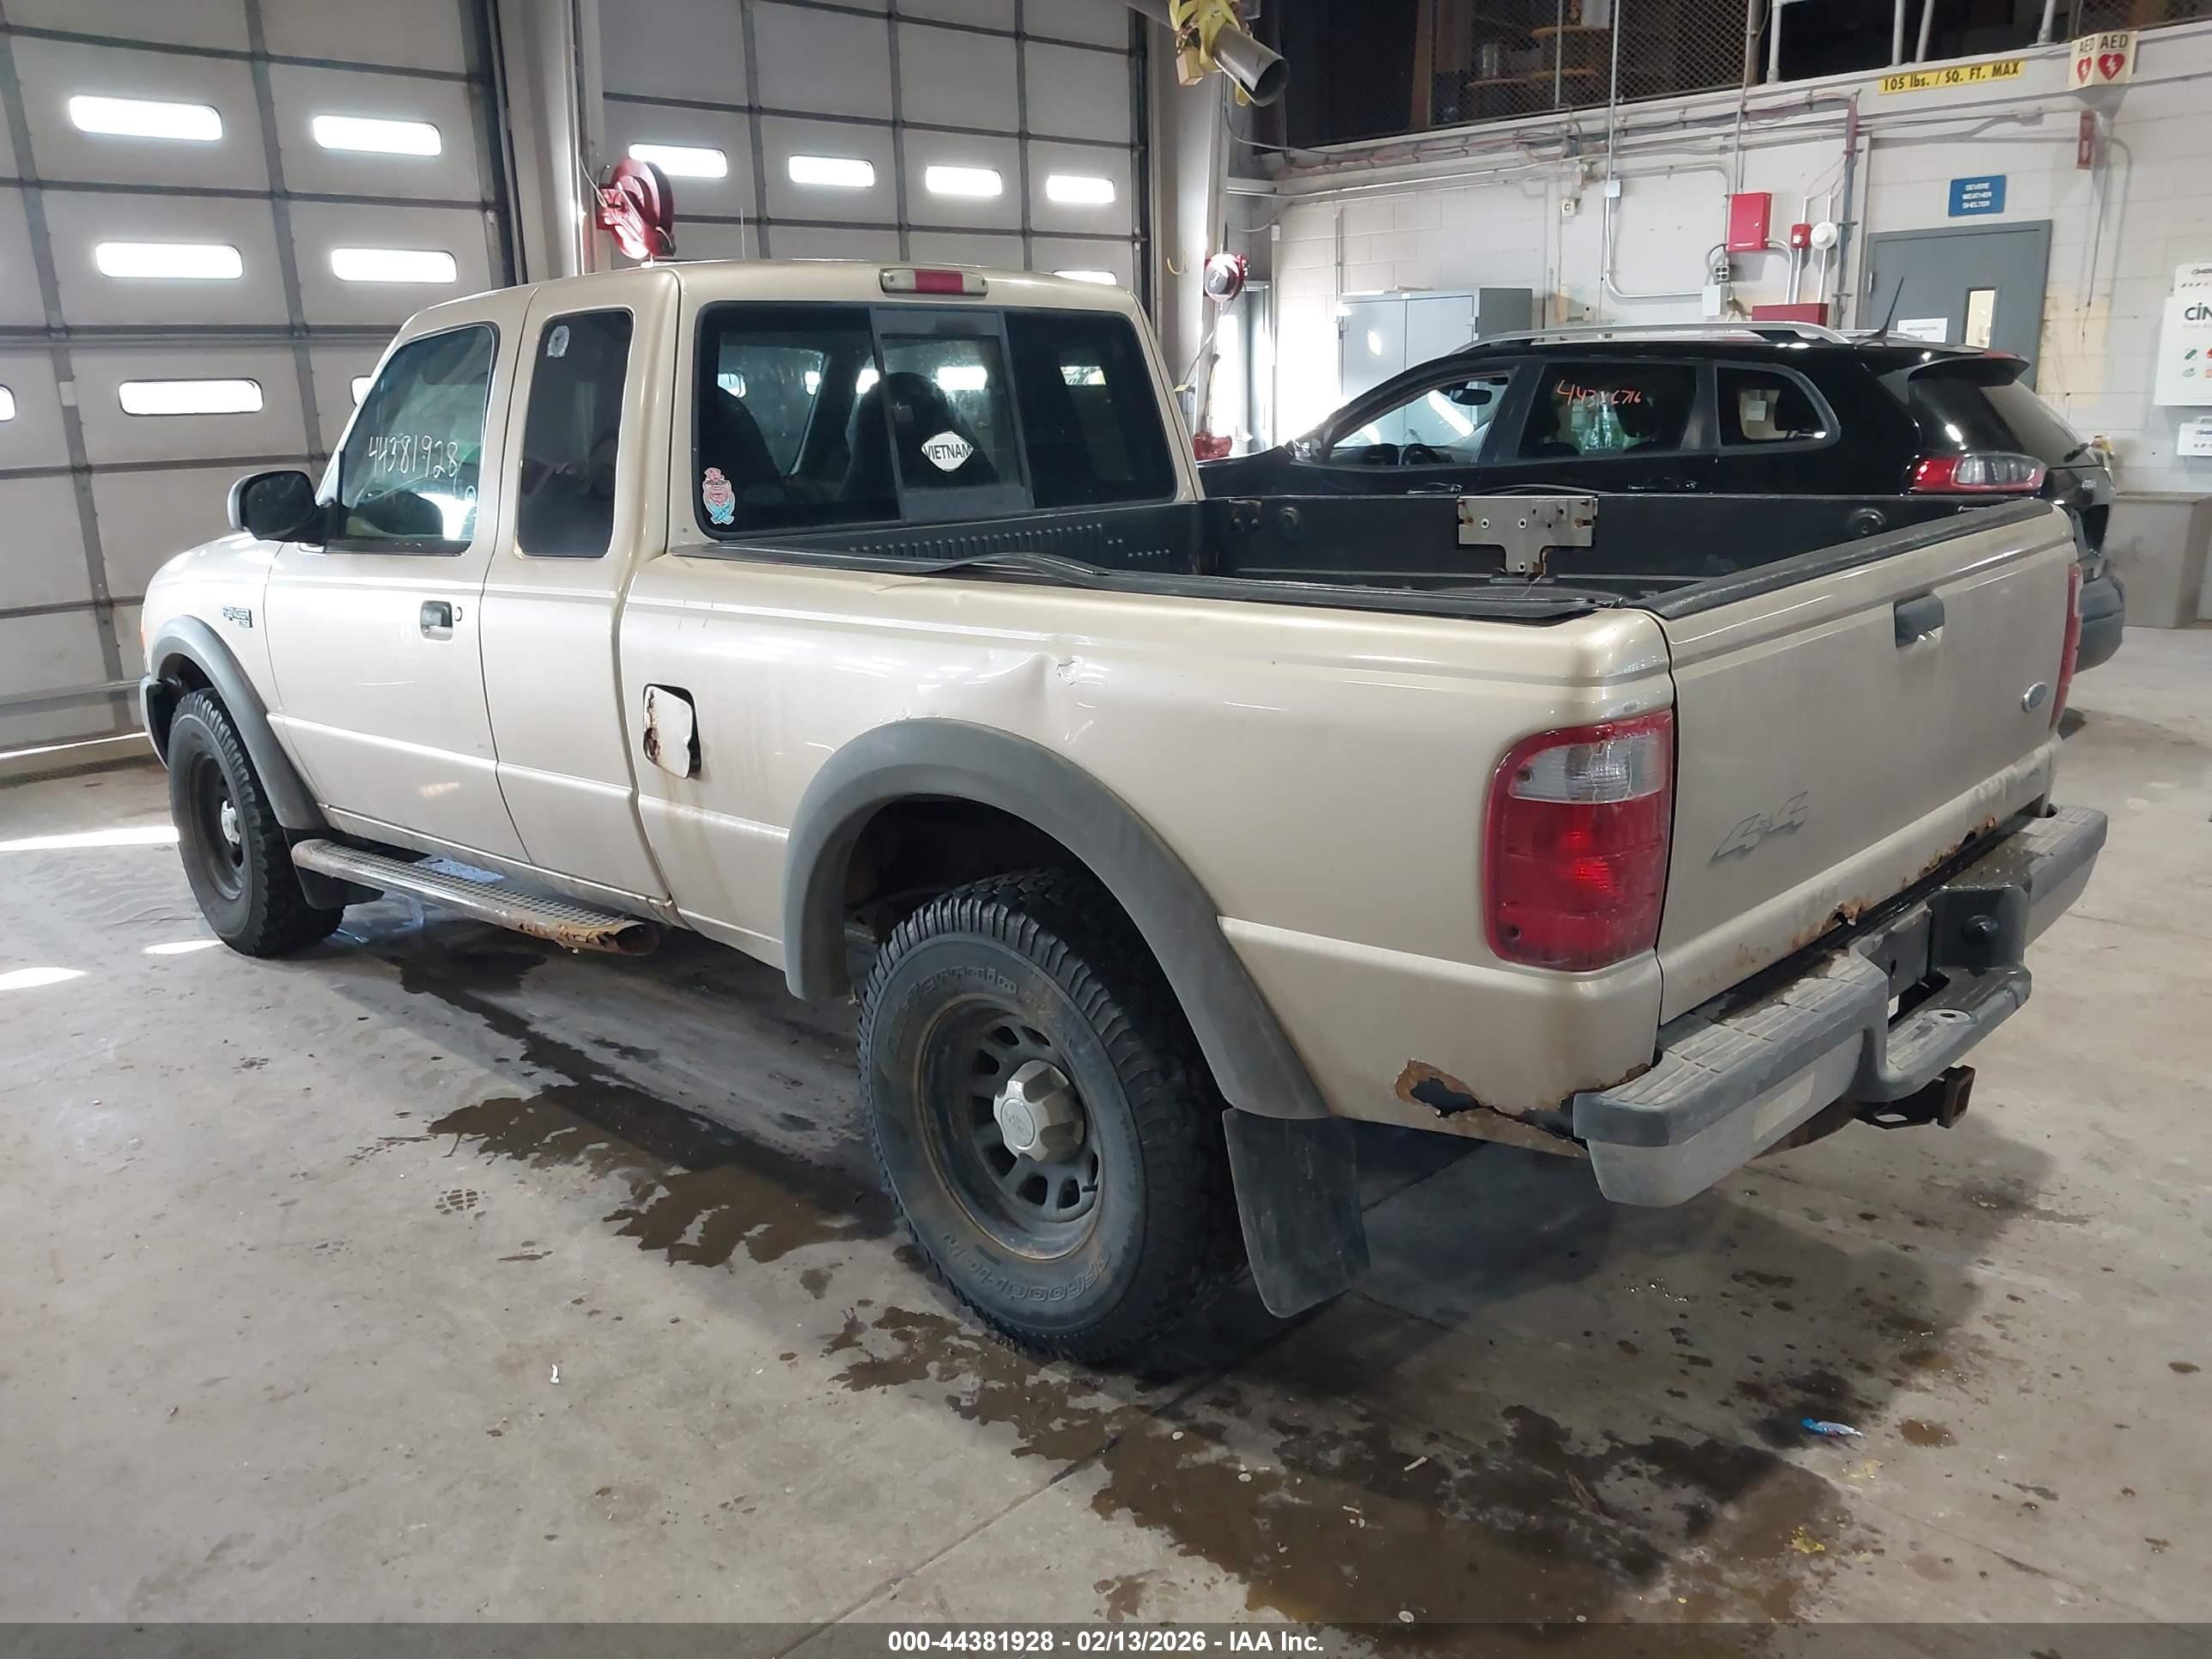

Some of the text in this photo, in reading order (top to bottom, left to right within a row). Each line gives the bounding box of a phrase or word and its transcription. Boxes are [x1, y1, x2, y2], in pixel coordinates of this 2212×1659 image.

[2100, 33, 2129, 49] AED
[1884, 76, 1905, 91] 105
[1910, 75, 1930, 88] lbs.
[1945, 69, 1964, 83] SQ.
[1969, 66, 1986, 80] FT.
[1991, 61, 2020, 77] MAX
[368, 434, 458, 479] 44381928
[923, 443, 973, 459] VIETNAM
